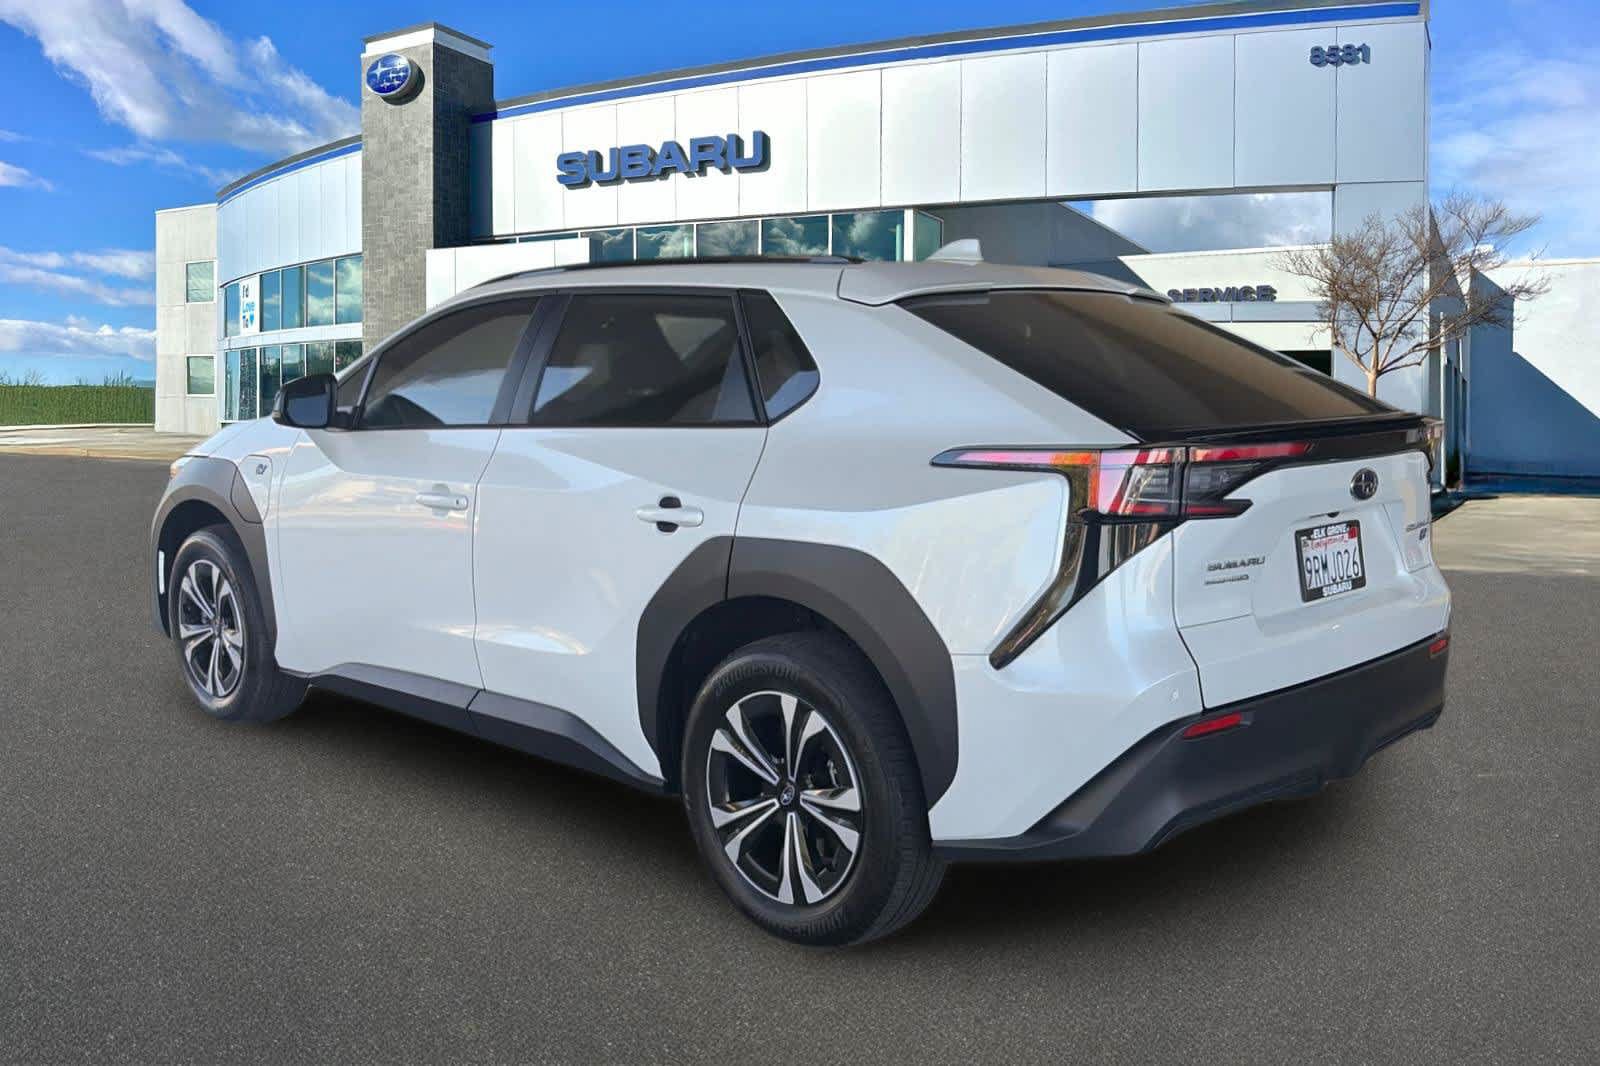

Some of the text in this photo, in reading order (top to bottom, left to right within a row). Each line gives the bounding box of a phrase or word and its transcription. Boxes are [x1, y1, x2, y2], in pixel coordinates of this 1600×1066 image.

[557, 131, 769, 188] SUBARU
[1167, 285, 1276, 302] SERVICE
[1207, 555, 1266, 571] SUBARU
[1305, 546, 1360, 589] 9RMJ026
